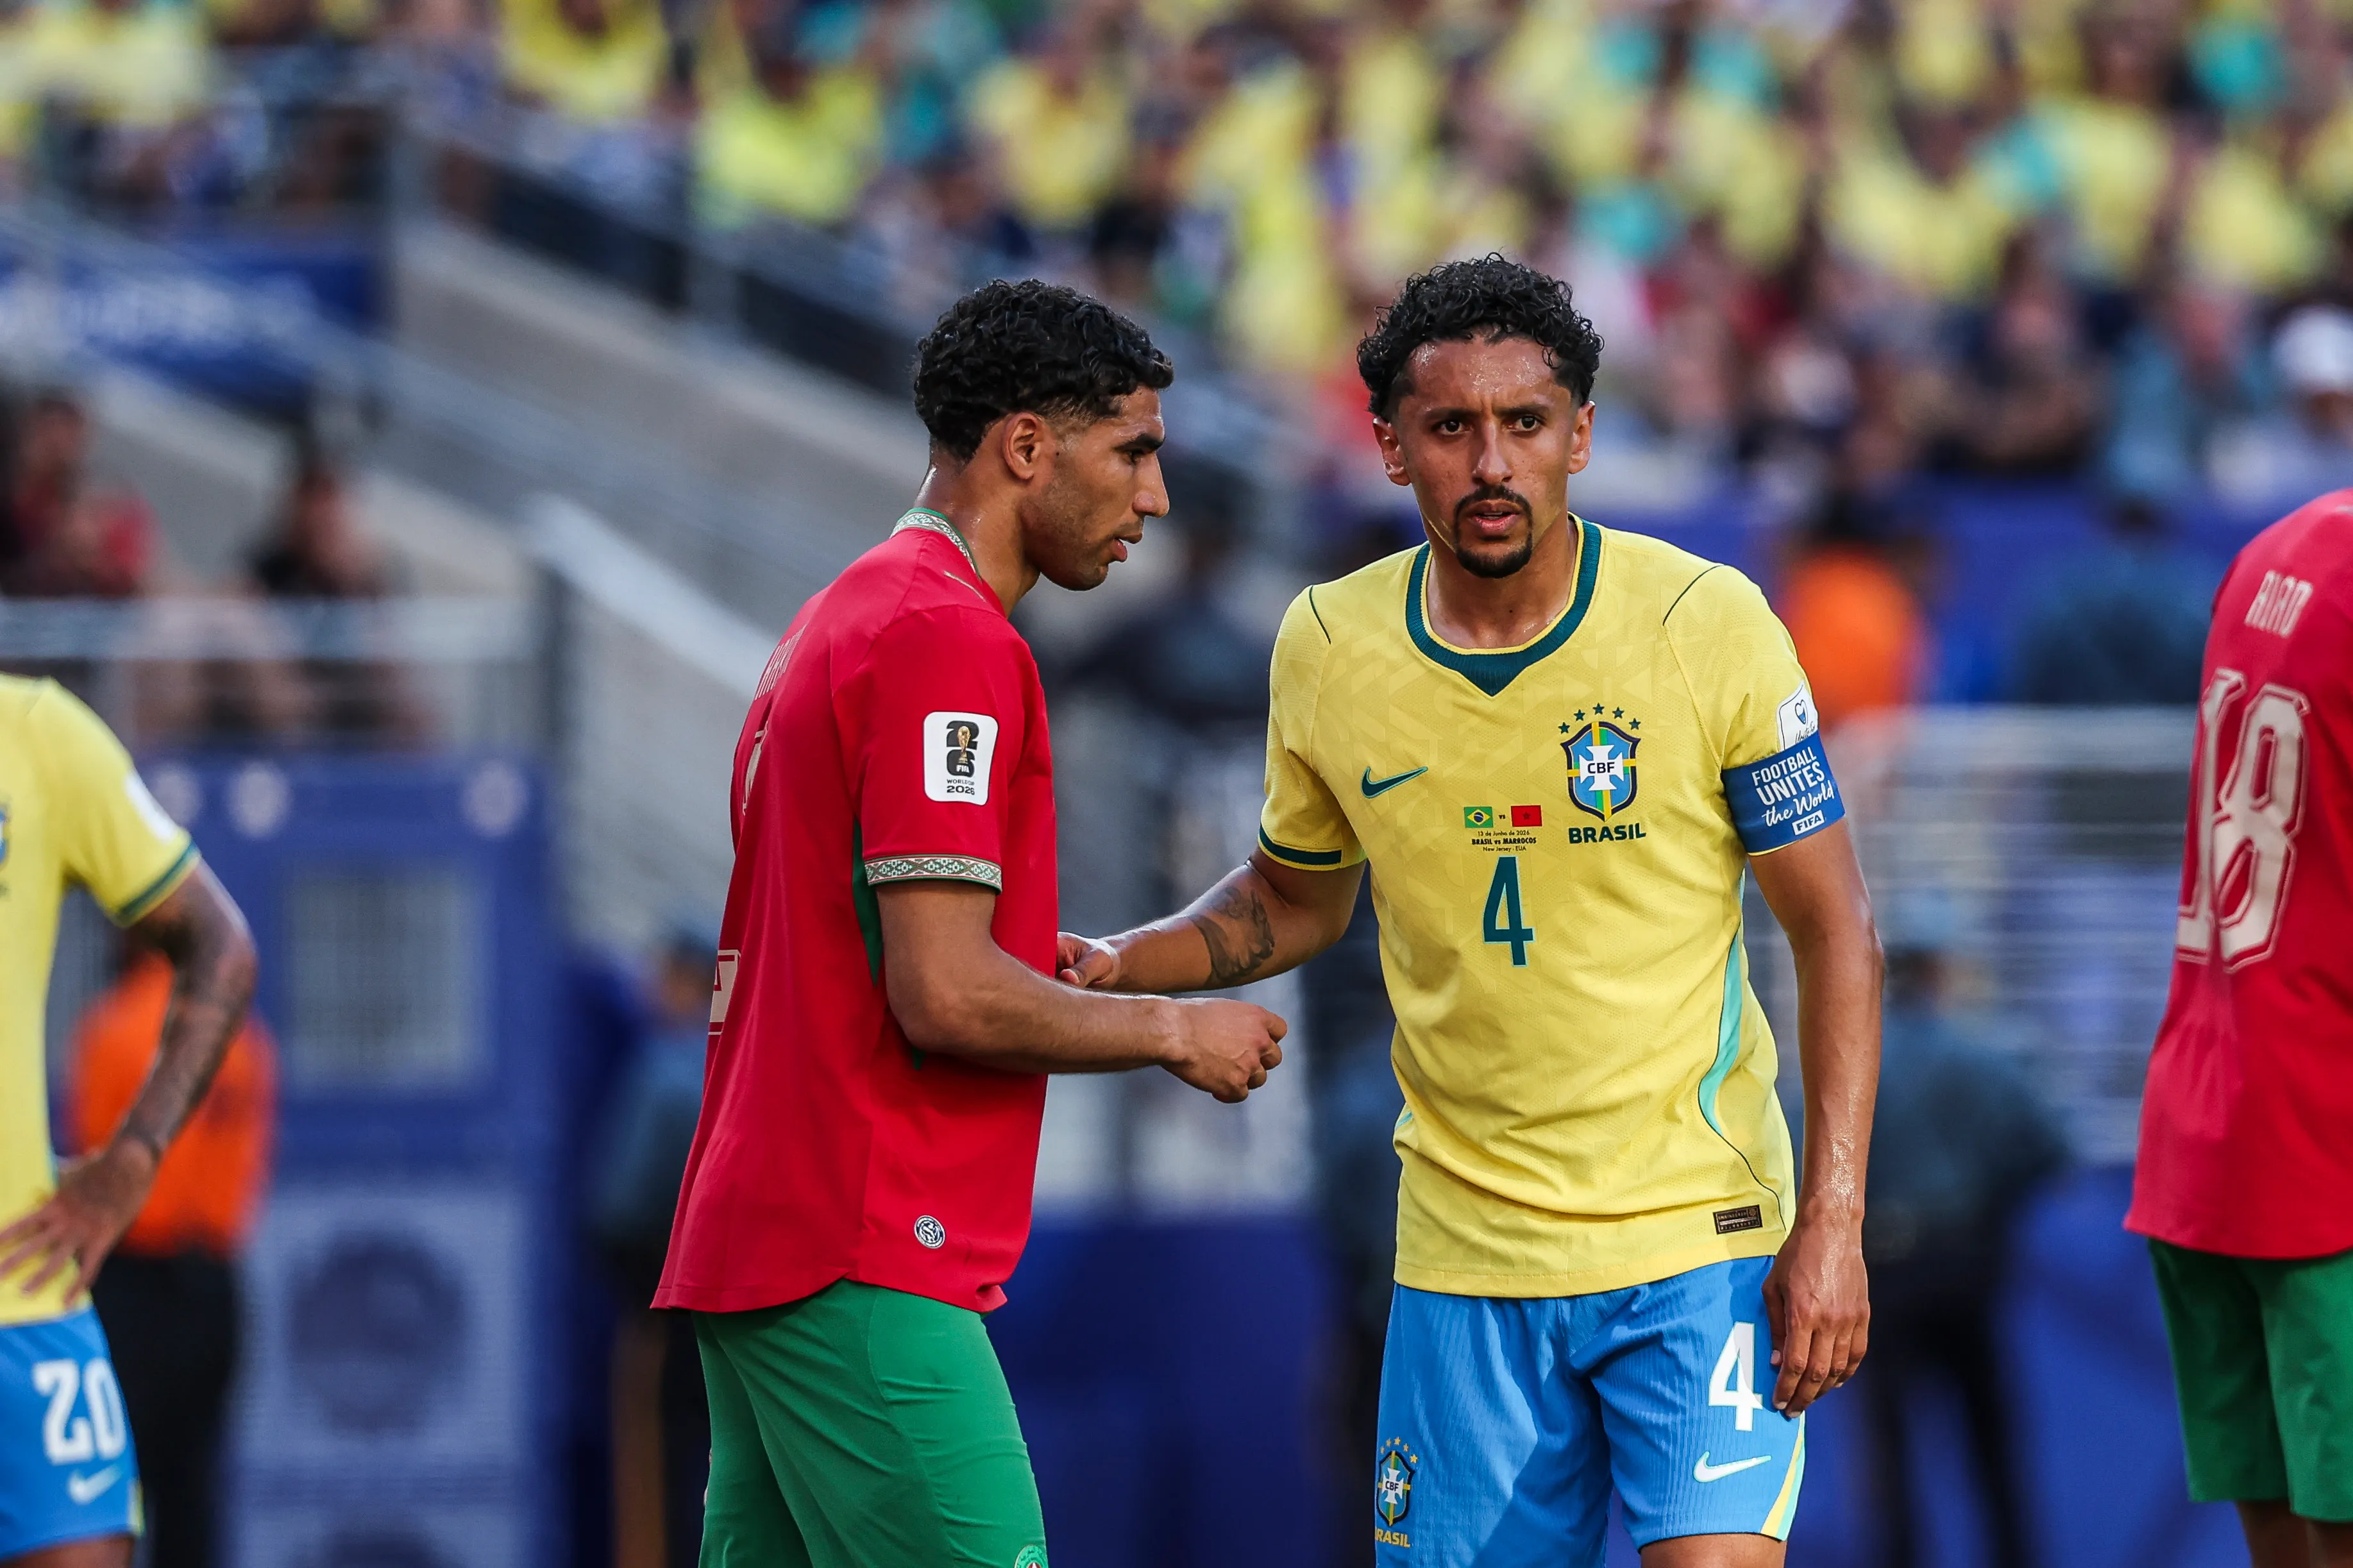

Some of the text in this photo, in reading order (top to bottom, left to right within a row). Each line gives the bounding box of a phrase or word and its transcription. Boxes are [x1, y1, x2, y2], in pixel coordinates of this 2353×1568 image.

[956, 764, 970, 773] FIFA
[1587, 761, 1615, 774] CBF
[1751, 746, 1817, 787] FOOTBALL
[947, 785, 975, 795] 2026
[1756, 762, 1825, 806] UNITES
[1761, 780, 1835, 827] the World
[1568, 823, 1646, 844] BRASIL
[1796, 816, 1823, 832] FIFA
[2176, 667, 2309, 973] 18
[1482, 856, 1535, 967] 4
[1708, 1321, 1763, 1431] 4
[33, 1358, 127, 1465] 20
[1385, 1480, 1399, 1492] CBF
[1375, 1527, 1411, 1548] RASIL
